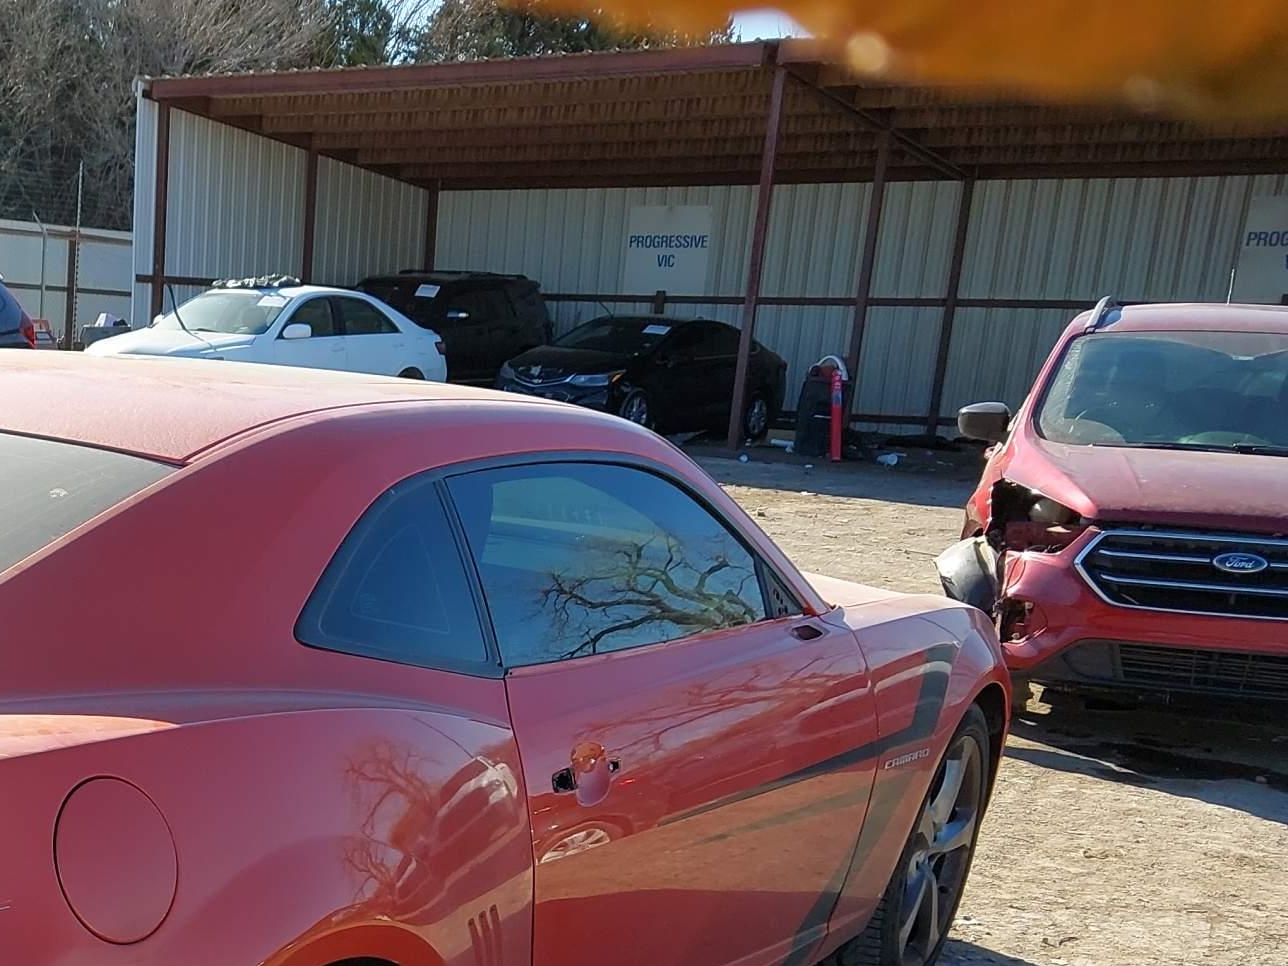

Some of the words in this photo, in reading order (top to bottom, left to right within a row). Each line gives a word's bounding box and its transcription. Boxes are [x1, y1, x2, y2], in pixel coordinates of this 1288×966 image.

[629, 234, 709, 249] PROGRESSIVE
[657, 254, 675, 268] VIC
[1225, 556, 1255, 569] Ford
[884, 748, 930, 770] CAMARO
